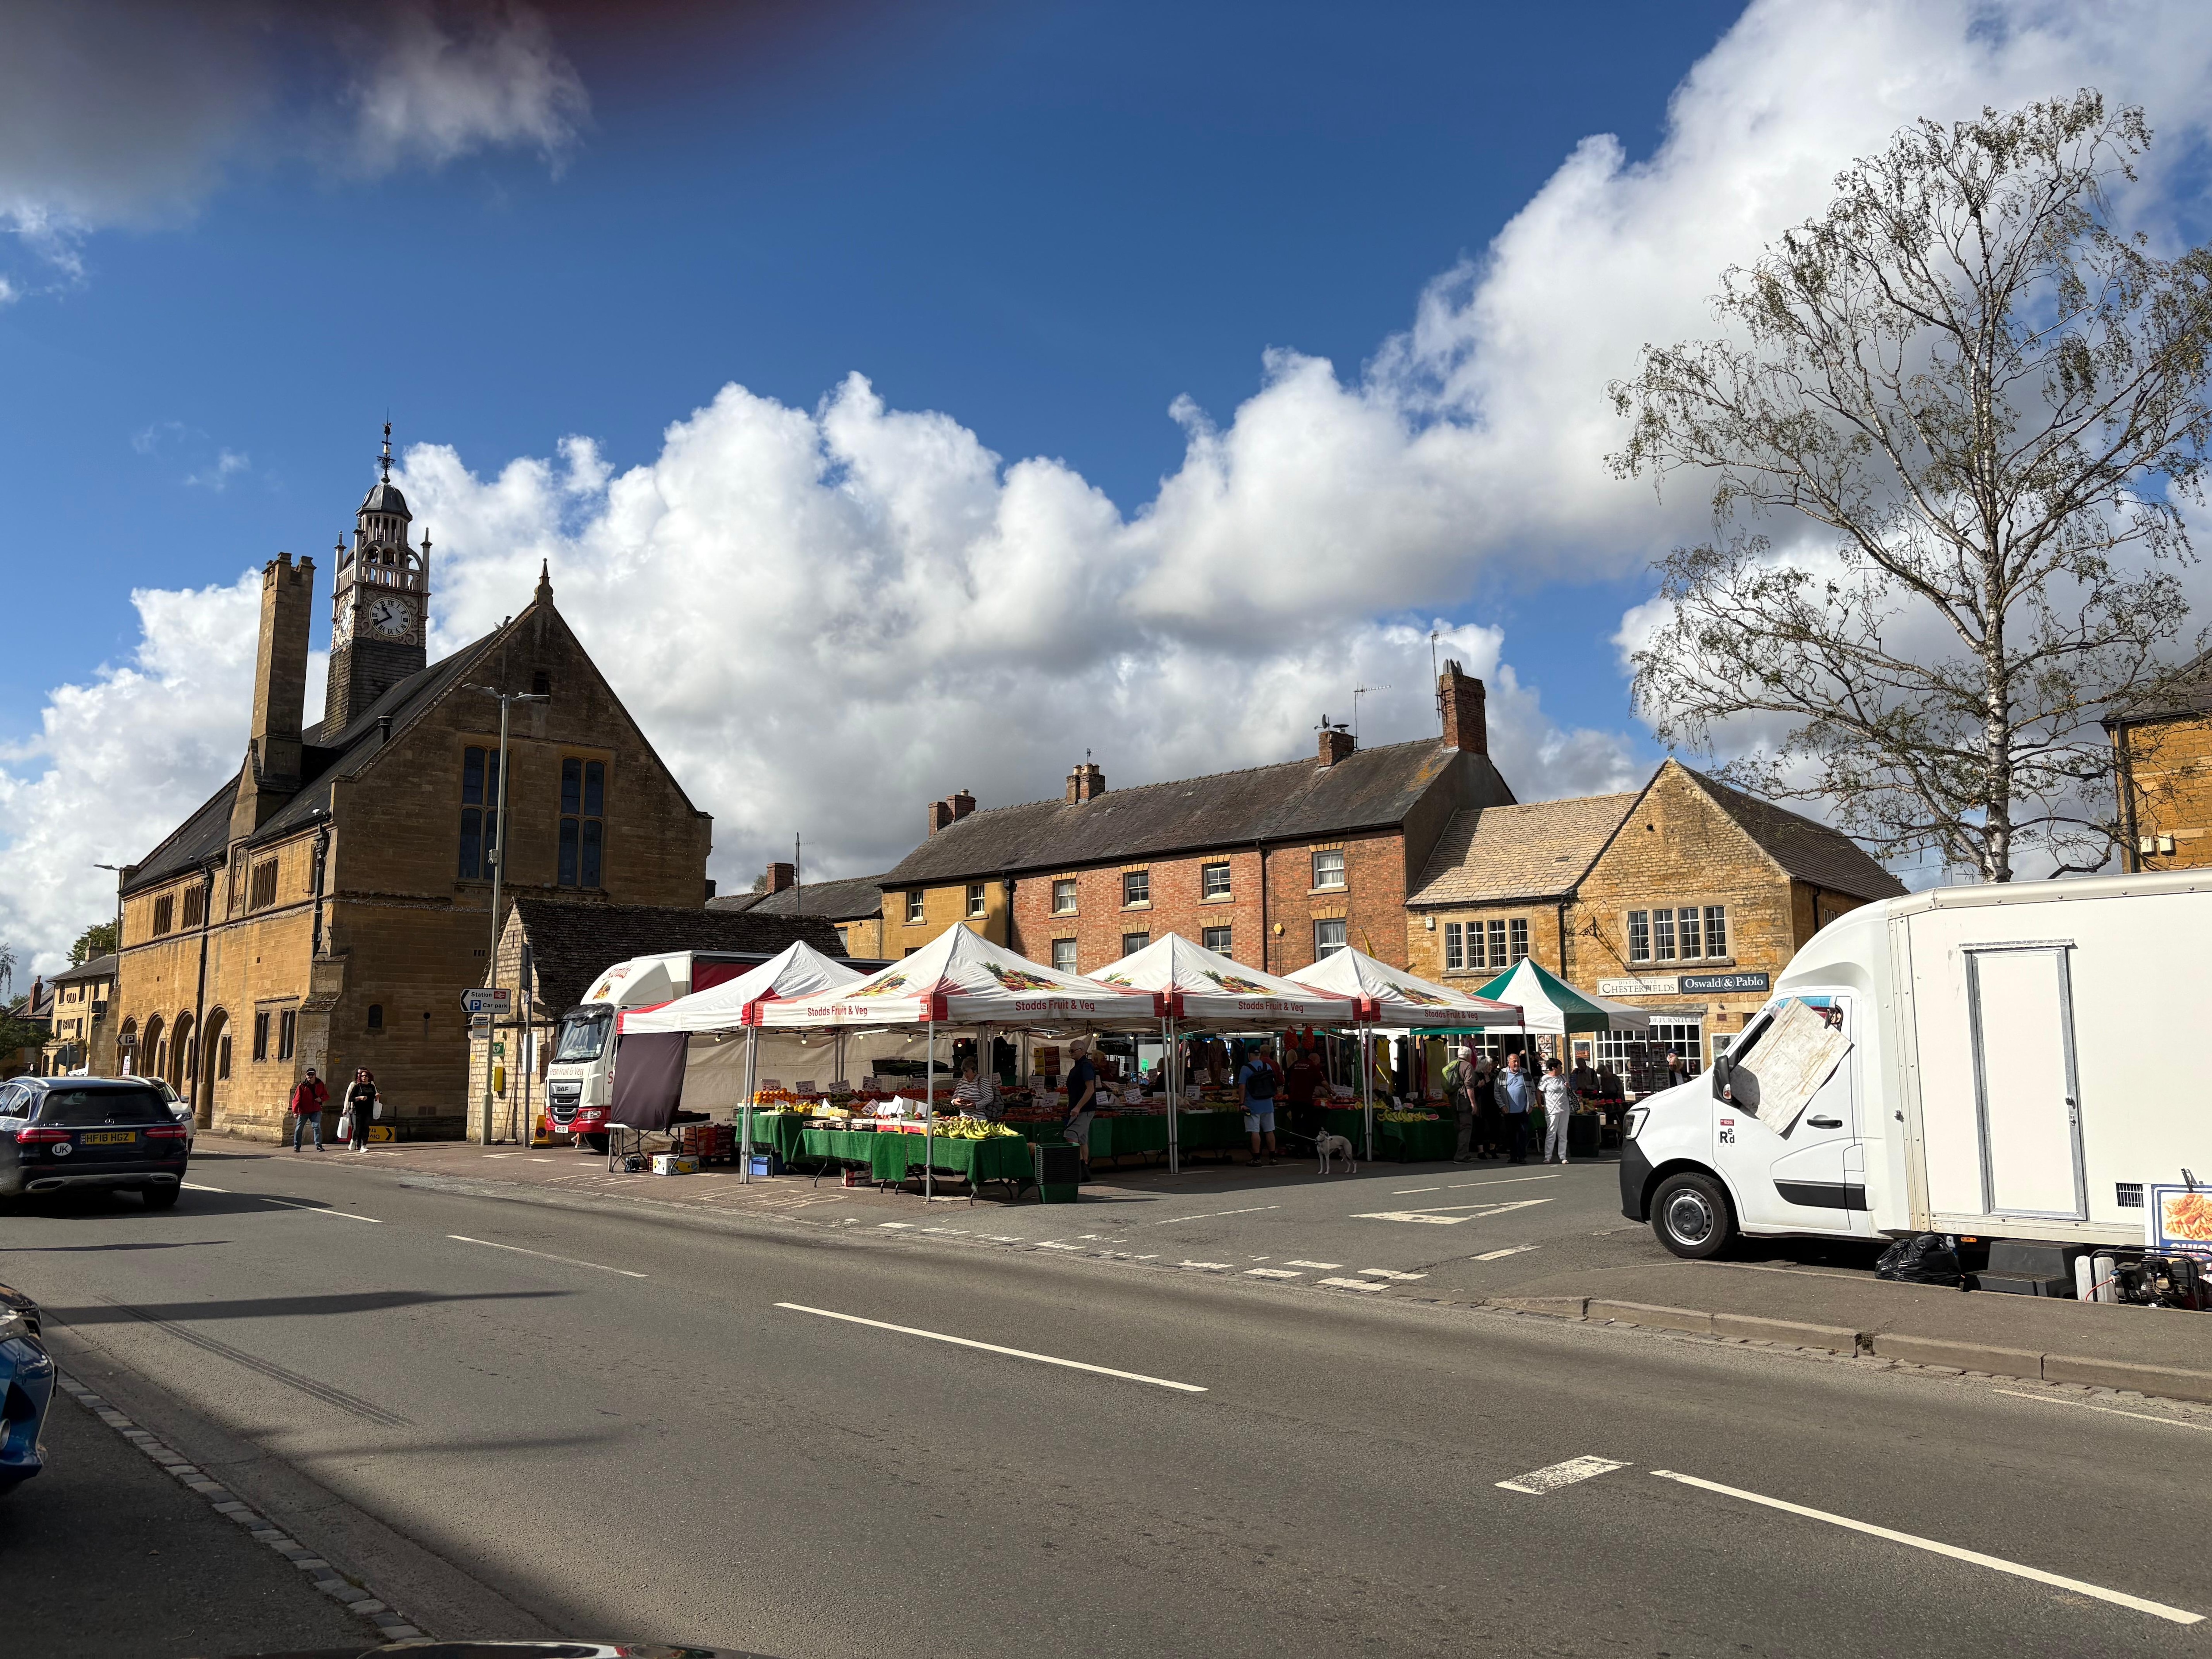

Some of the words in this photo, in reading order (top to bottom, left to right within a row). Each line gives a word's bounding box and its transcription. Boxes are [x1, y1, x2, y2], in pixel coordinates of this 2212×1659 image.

[1685, 978, 1721, 988] Oswald
[1724, 978, 1733, 987] &
[1736, 976, 1763, 987] Pablo
[66, 992, 77, 1003] OLD
[807, 1006, 830, 1017] Stodds
[832, 1005, 847, 1015] Fruit
[849, 1005, 853, 1015] &
[855, 1005, 868, 1017] Veg
[1015, 1000, 1047, 1011] Stodds
[1049, 999, 1069, 1010] Fruit
[1071, 999, 1077, 1009] &
[1079, 1000, 1095, 1012] Veg
[1238, 1001, 1264, 1010] Stodds
[1265, 1001, 1283, 1010] Fruit
[1284, 1002, 1289, 1010] &
[1290, 1002, 1304, 1013] Veg
[1424, 1010, 1446, 1018] Stodds
[1467, 1011, 1478, 1021] Veg
[63, 1018, 76, 1030] BANK
[575, 1067, 584, 1078] Veg
[111, 1133, 129, 1141] HGZ
[55, 1145, 68, 1153] UK
